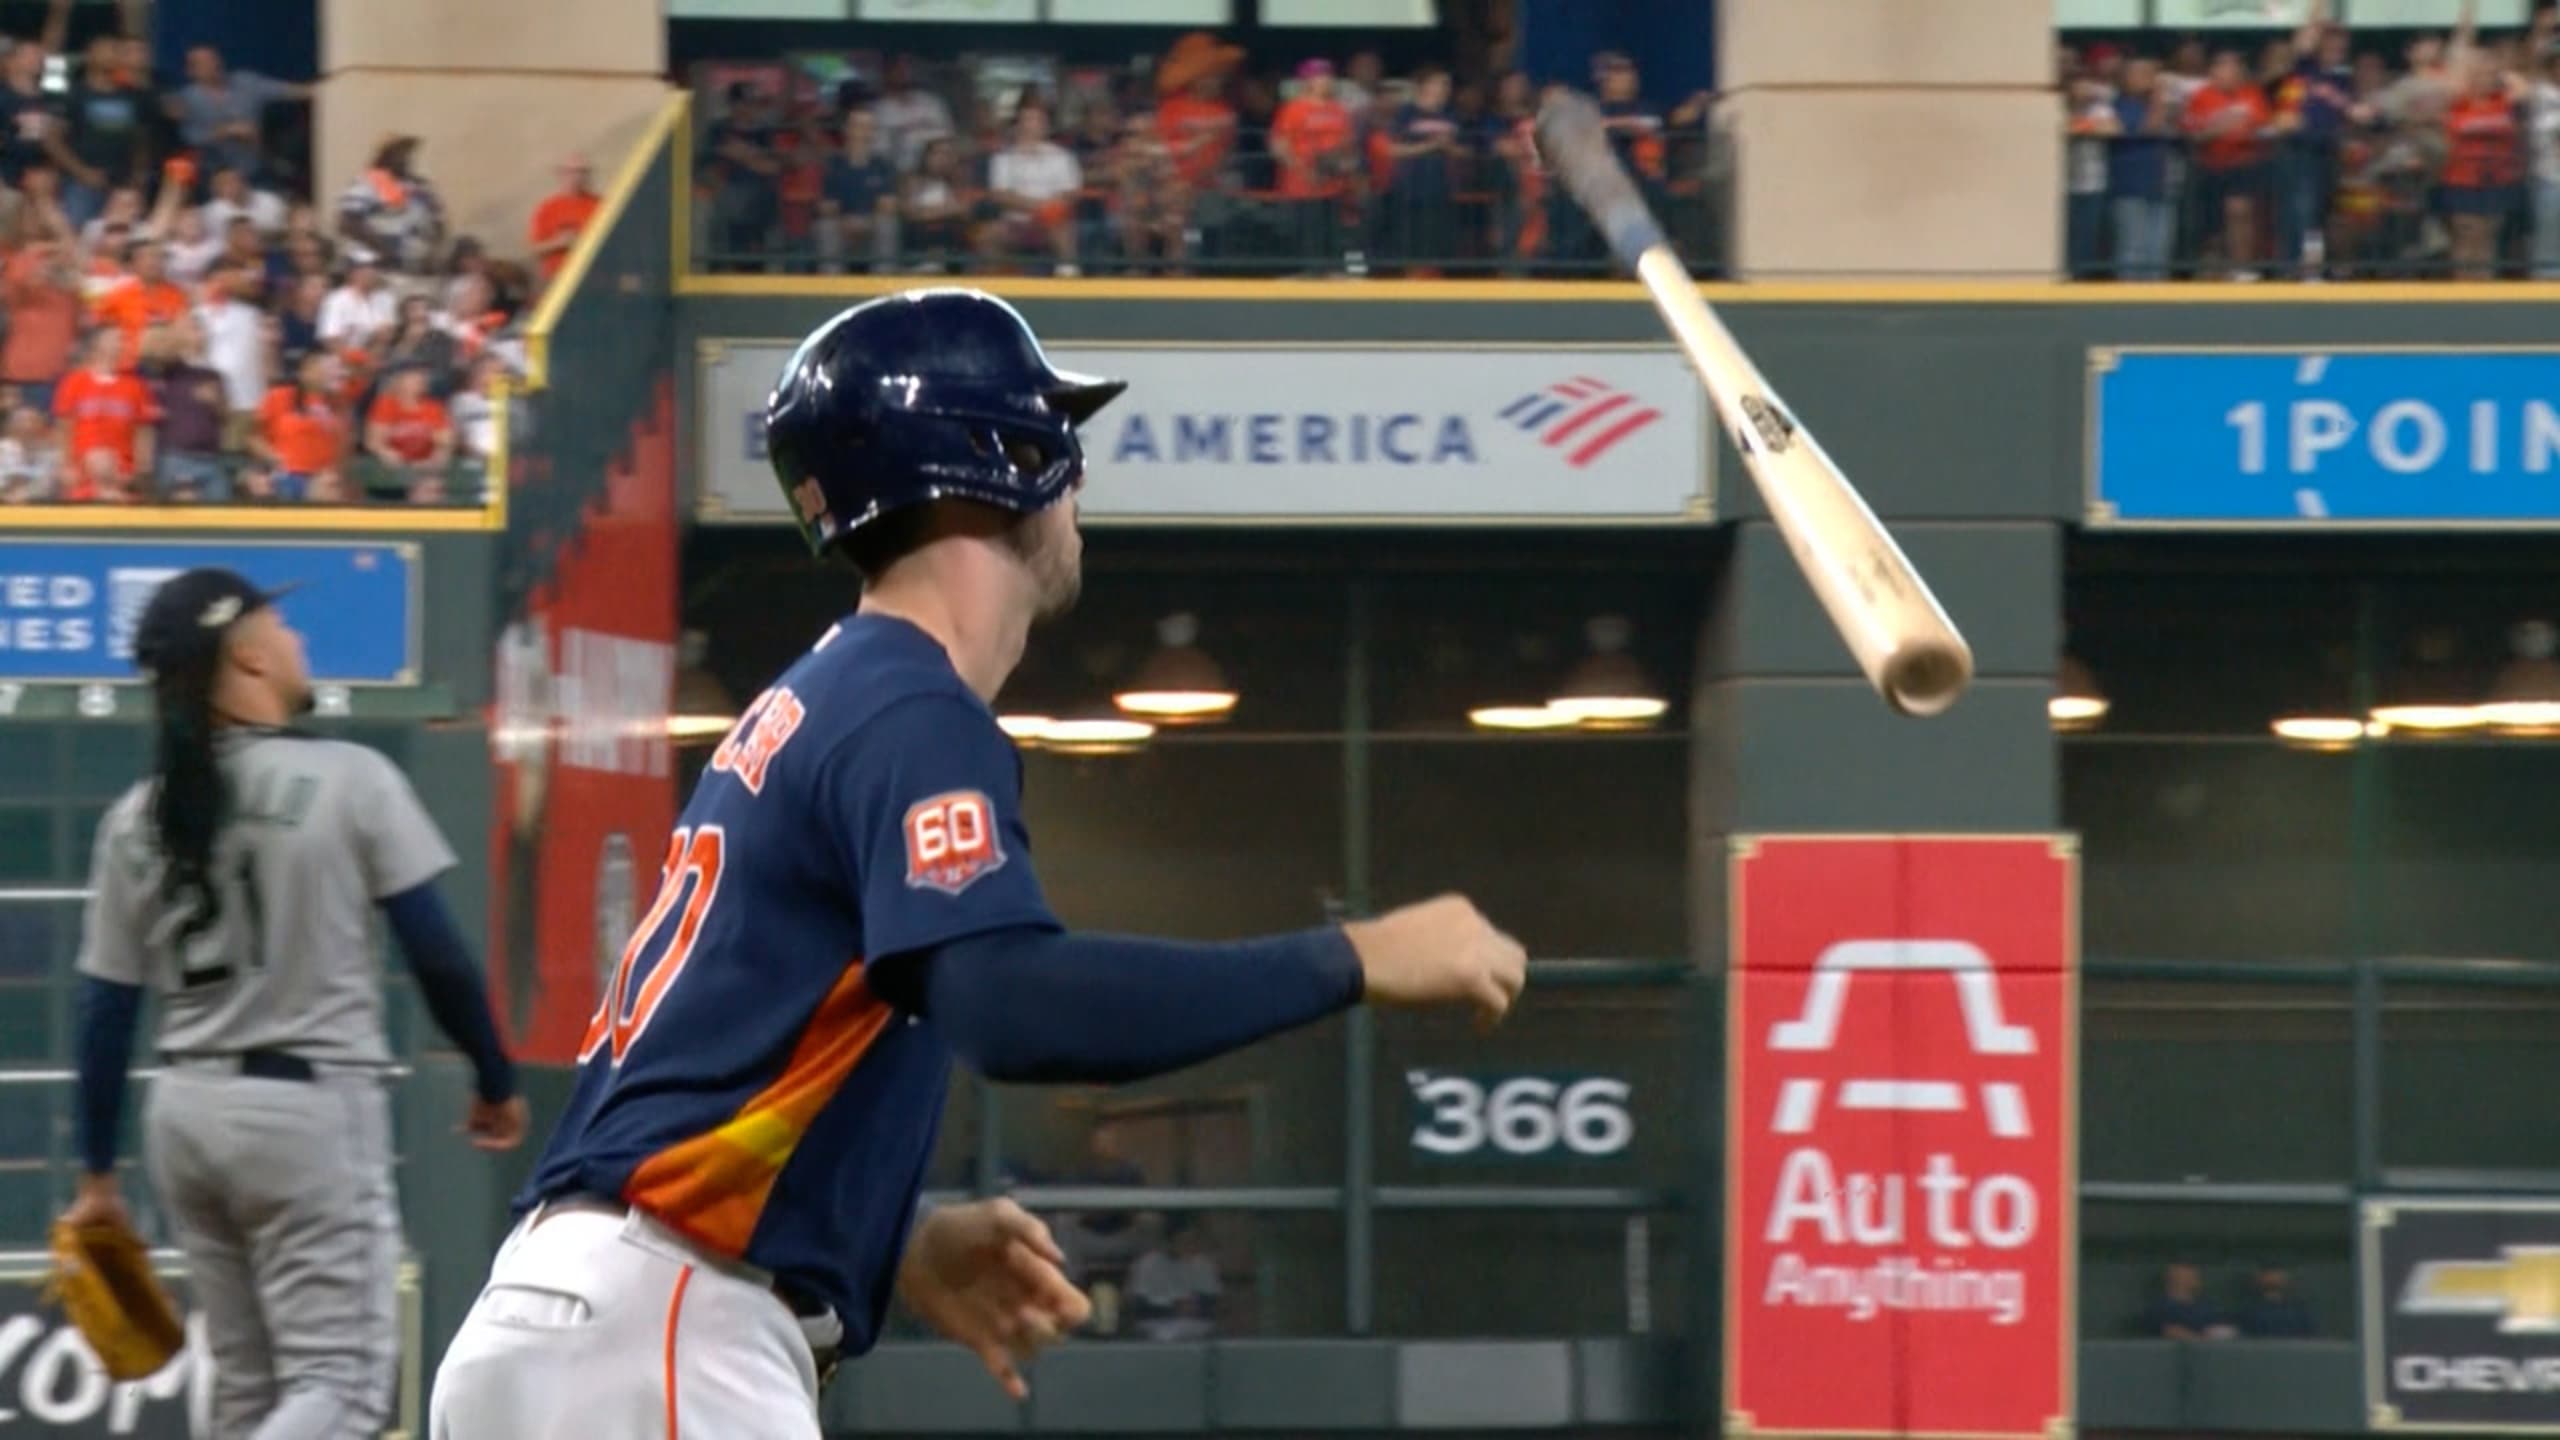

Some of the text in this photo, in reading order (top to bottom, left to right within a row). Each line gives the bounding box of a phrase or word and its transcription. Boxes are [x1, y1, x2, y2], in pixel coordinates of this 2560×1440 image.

[1111, 413, 1478, 465] AMERICA
[78, 683, 115, 717] 8
[915, 801, 986, 863] 60
[163, 846, 267, 988] 21
[1411, 1076, 1634, 1154] 366
[1763, 1147, 2039, 1249] Auto
[1762, 1253, 2025, 1325] Anything
